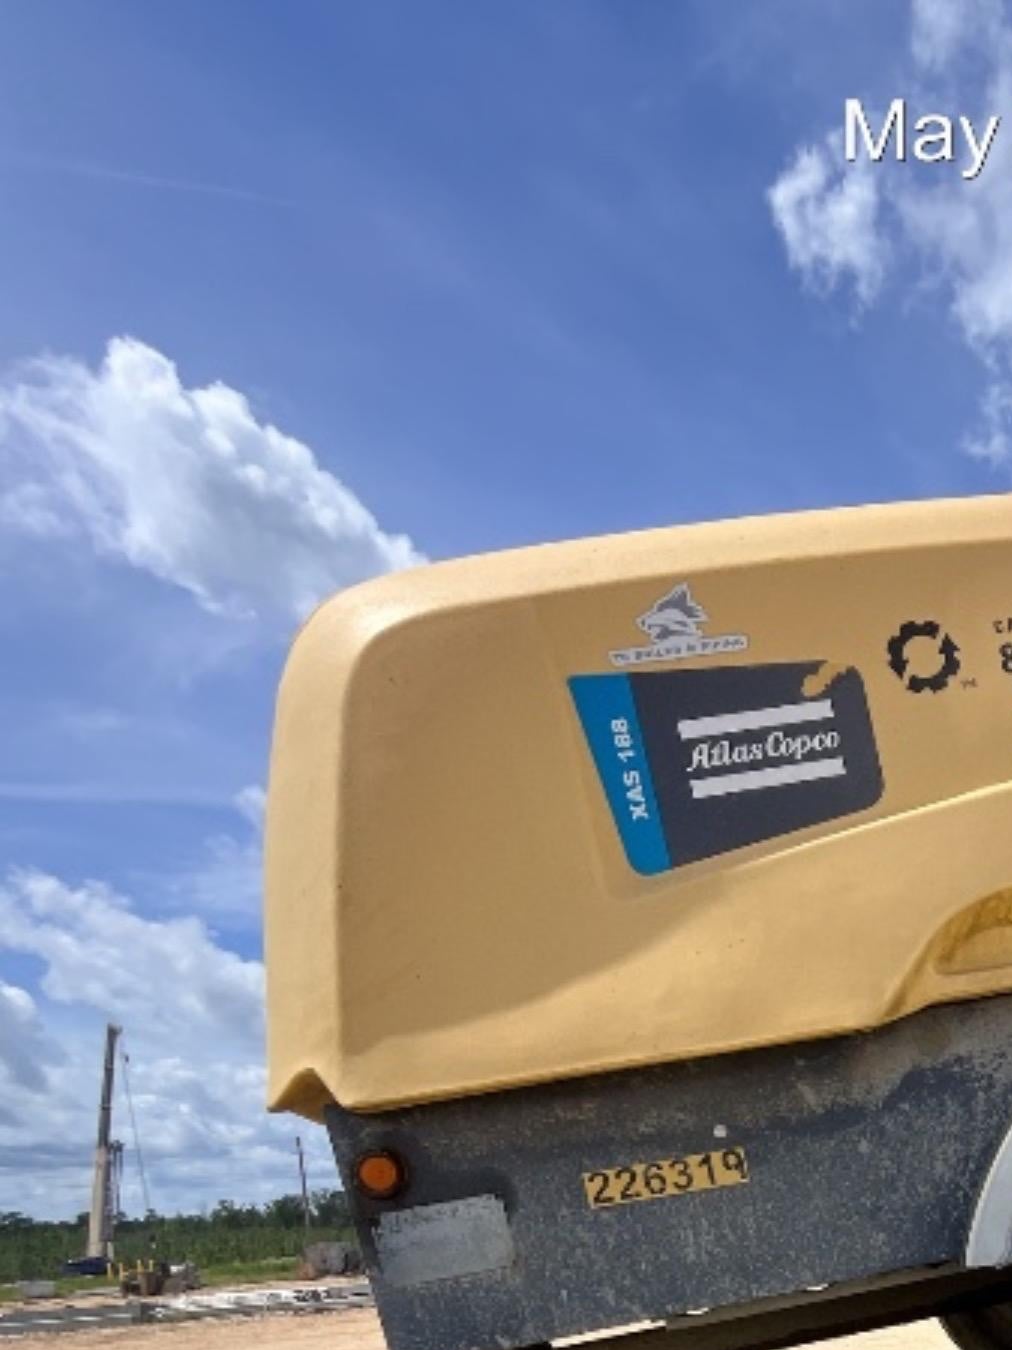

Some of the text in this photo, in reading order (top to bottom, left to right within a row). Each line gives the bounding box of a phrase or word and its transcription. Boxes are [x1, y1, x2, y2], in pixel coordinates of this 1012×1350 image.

[610, 718, 649, 821] XAS 188
[587, 1149, 748, 1204] 226319
